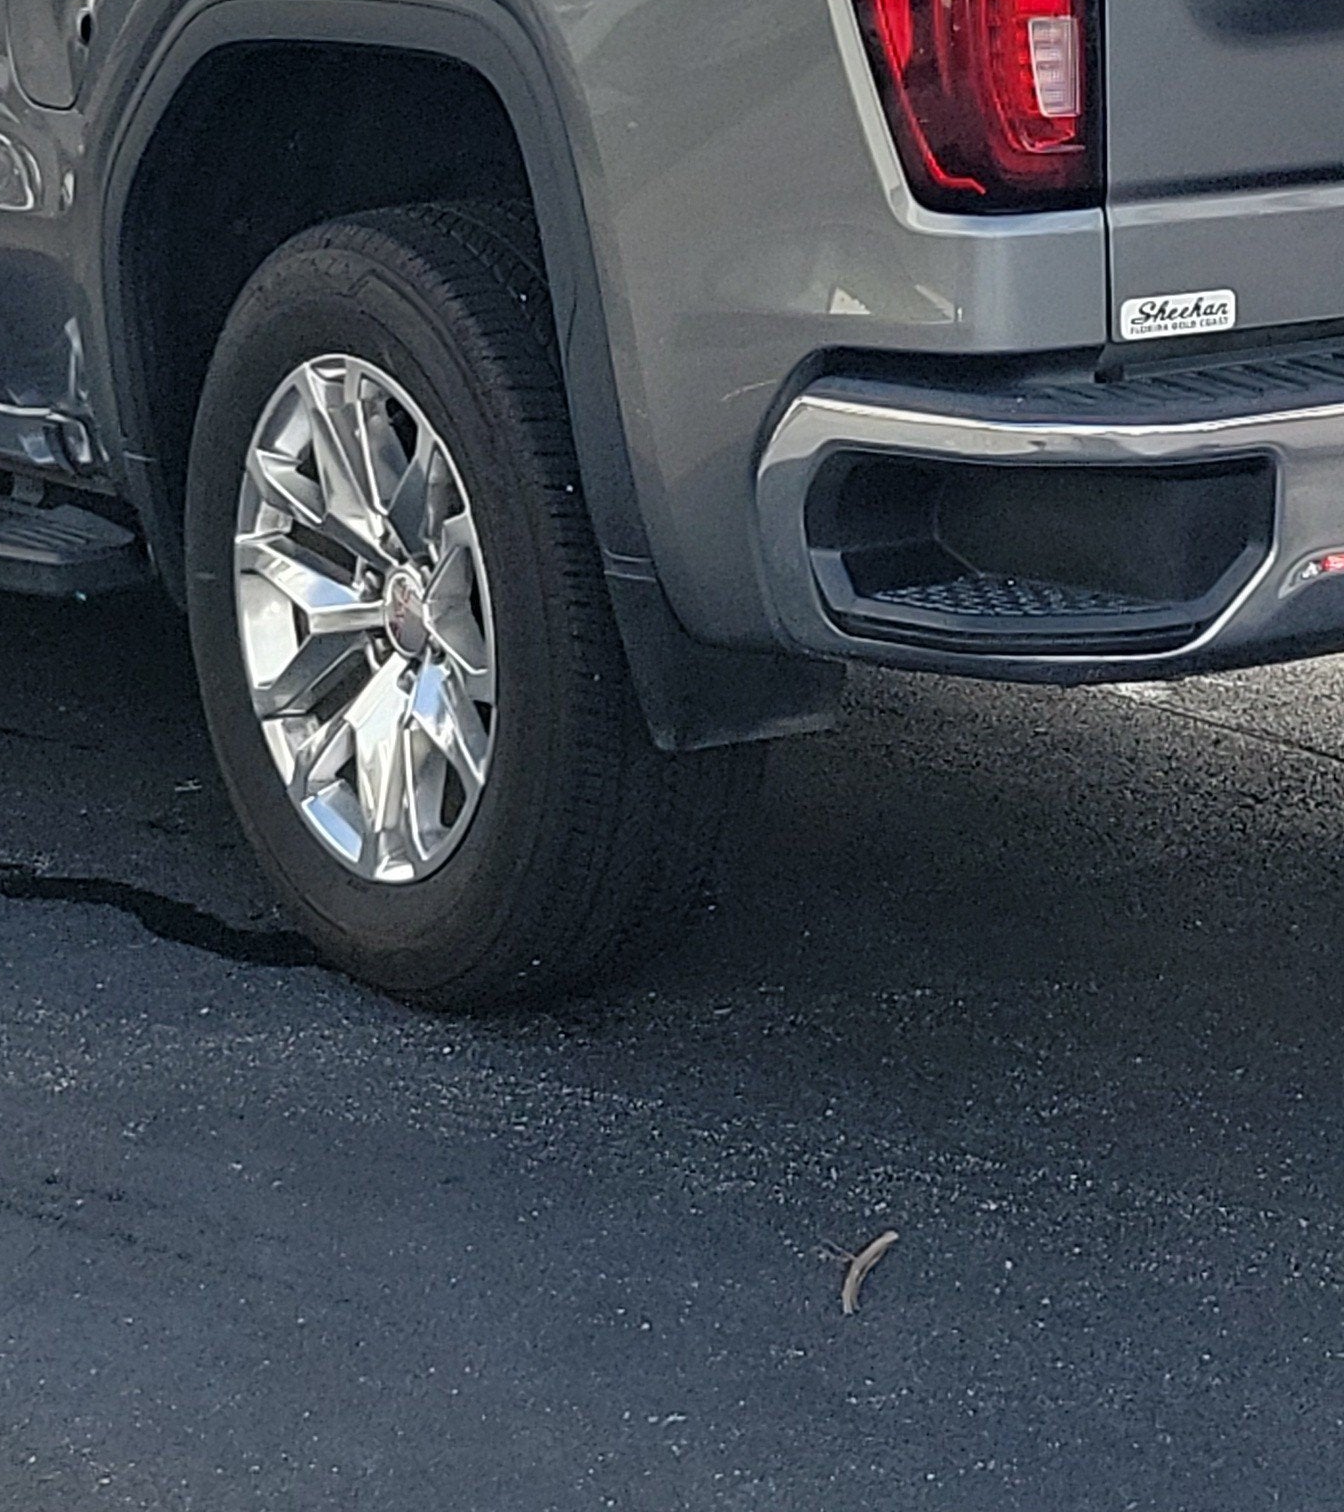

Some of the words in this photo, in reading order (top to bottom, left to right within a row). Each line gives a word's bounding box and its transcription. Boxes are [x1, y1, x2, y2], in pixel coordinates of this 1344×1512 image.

[1130, 297, 1228, 325] Sheehan
[1171, 320, 1197, 331] GOLD
[1199, 316, 1229, 328] COAST
